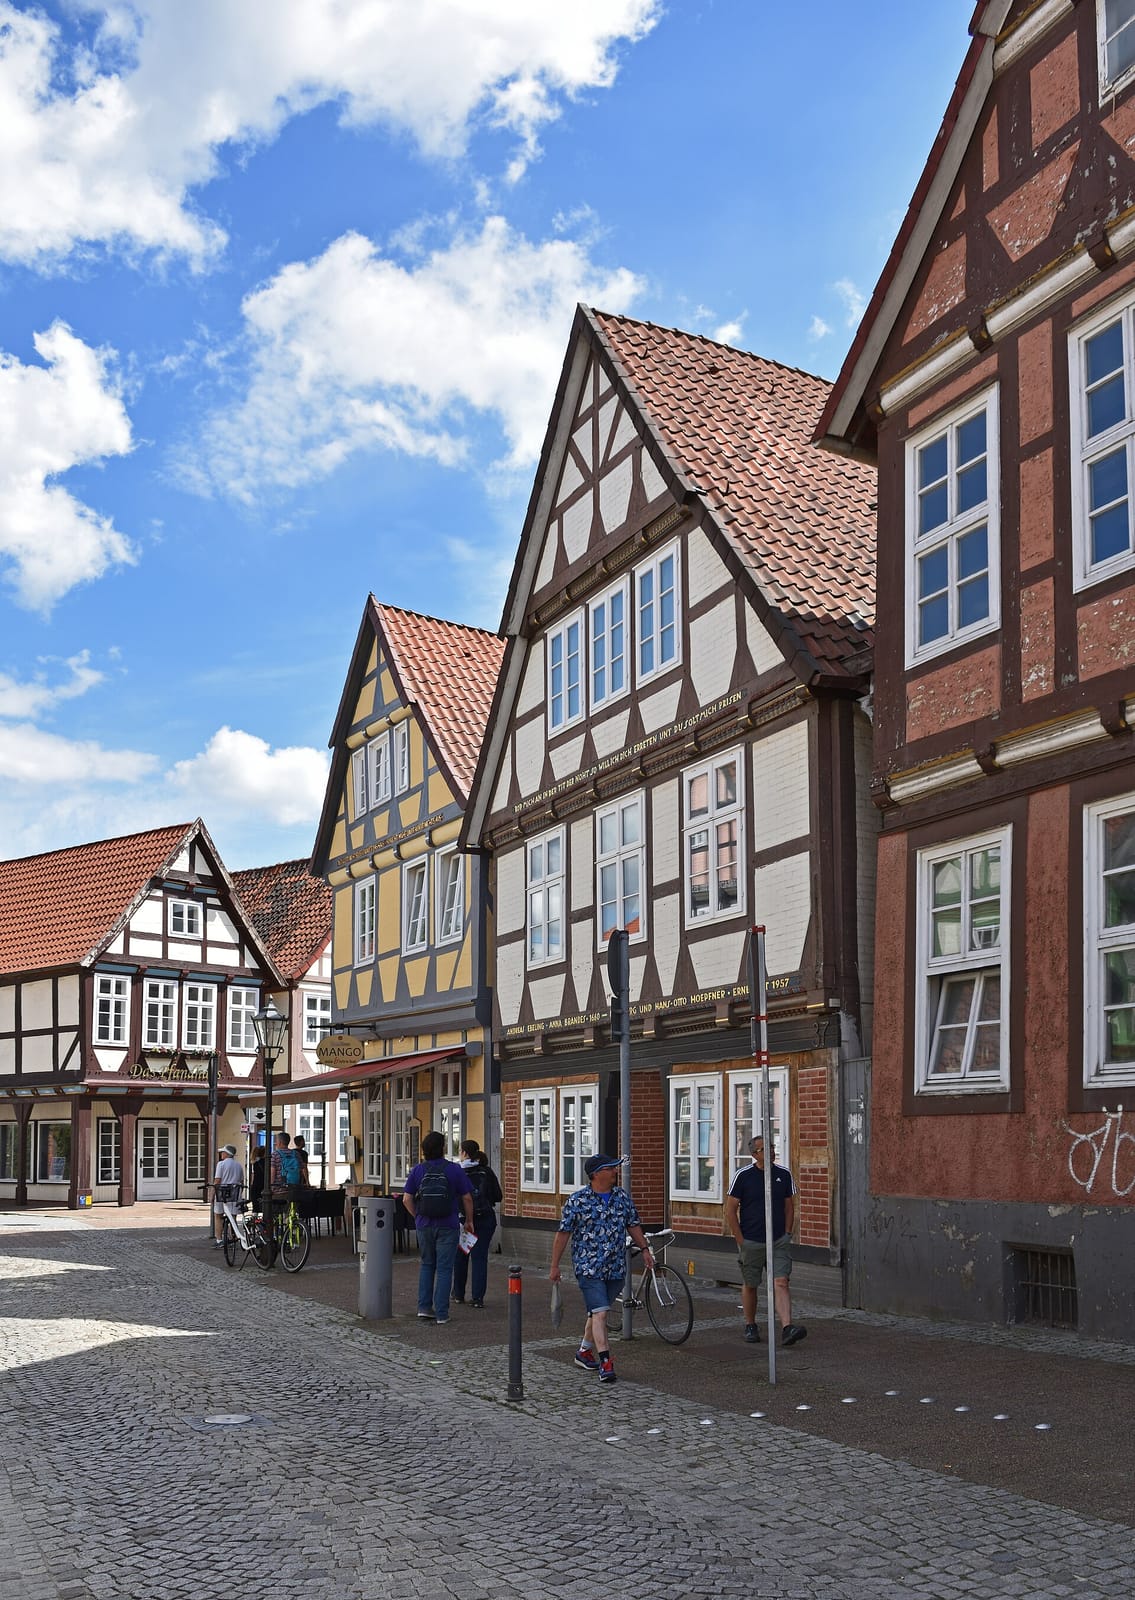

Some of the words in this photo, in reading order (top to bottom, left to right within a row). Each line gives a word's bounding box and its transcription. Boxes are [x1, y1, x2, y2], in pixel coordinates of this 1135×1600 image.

[674, 723, 683, 734] DU
[700, 704, 717, 721] MICH
[718, 691, 742, 710] PRISEN
[528, 1022, 544, 1032] EBELING
[548, 1020, 562, 1028] ANNA
[564, 1015, 586, 1026] BRANDES
[639, 1003, 652, 1014] UND
[690, 990, 726, 1004] HOEPFNER
[772, 978, 790, 989] 1957
[812, 1020, 829, 1048] 37
[318, 1048, 362, 1056] MANGO
[130, 1064, 156, 1078] Das
[160, 1063, 223, 1082] Pfandhas
